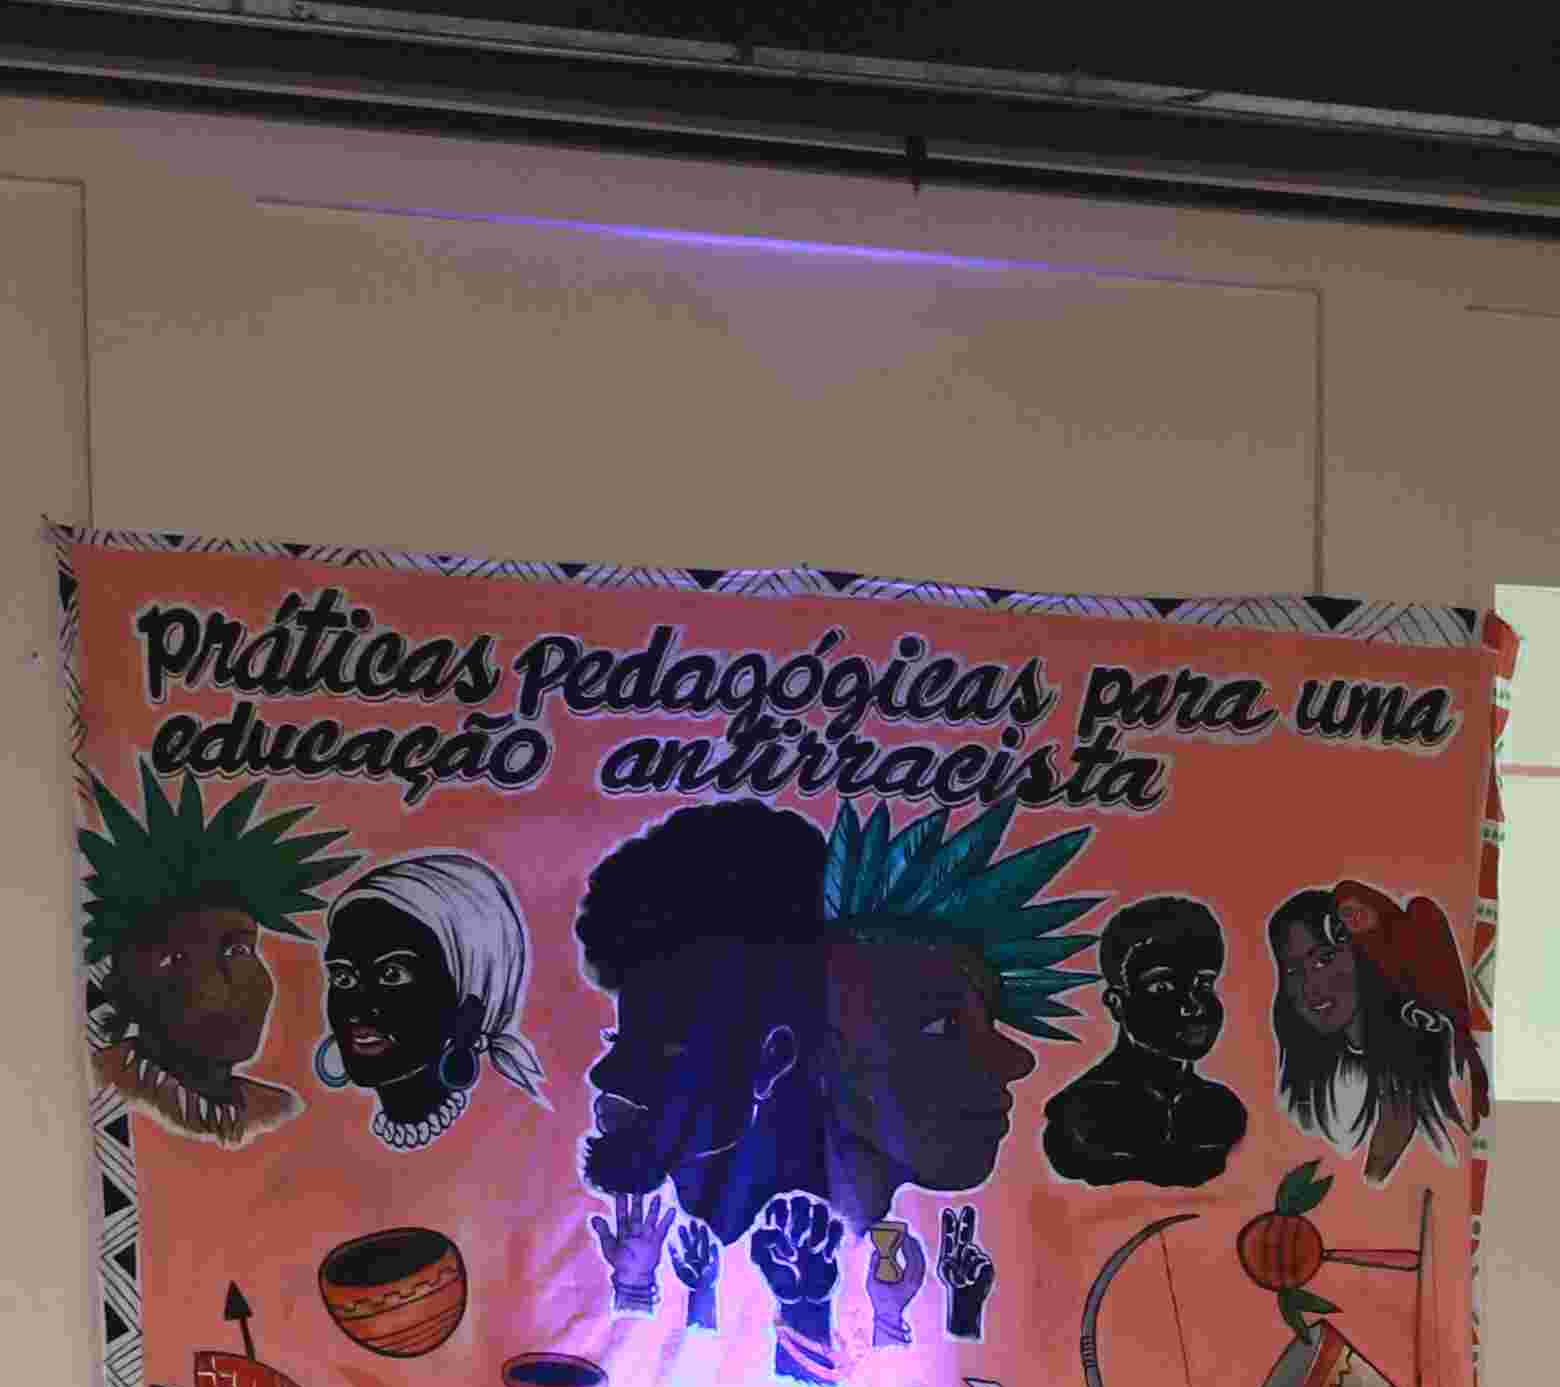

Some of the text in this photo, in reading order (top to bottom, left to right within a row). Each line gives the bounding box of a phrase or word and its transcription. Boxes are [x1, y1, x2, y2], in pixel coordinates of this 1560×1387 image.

[1078, 665, 1278, 737] para
[1296, 677, 1455, 745] uma
[151, 702, 1166, 809] educação antirracista
